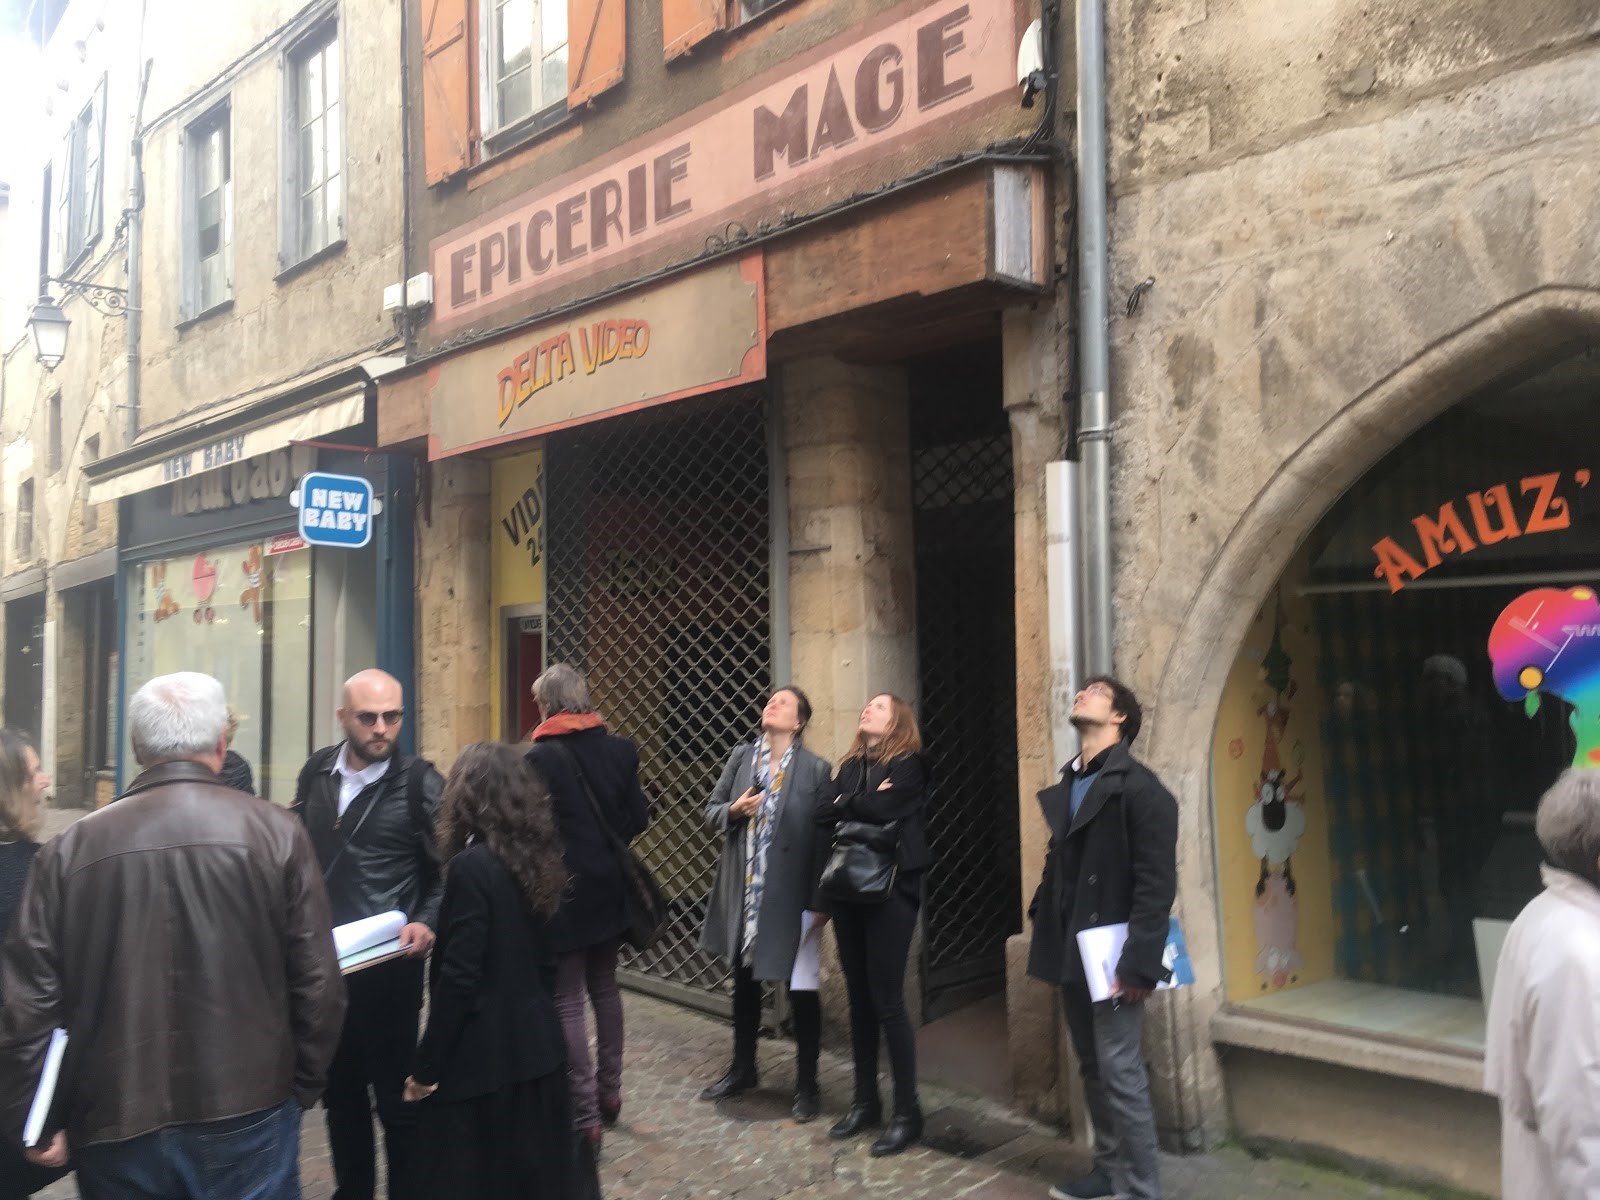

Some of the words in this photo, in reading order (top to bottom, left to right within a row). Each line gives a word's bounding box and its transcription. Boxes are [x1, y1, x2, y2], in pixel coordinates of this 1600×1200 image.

[450, 142, 692, 309] EPICERIE
[753, 4, 975, 183] MAGE
[496, 331, 576, 429] DELTA
[578, 319, 651, 376] VIDEO
[164, 453, 194, 481] NEW
[203, 435, 245, 469] BABY
[304, 508, 367, 532] BABY
[311, 488, 364, 511] NEW
